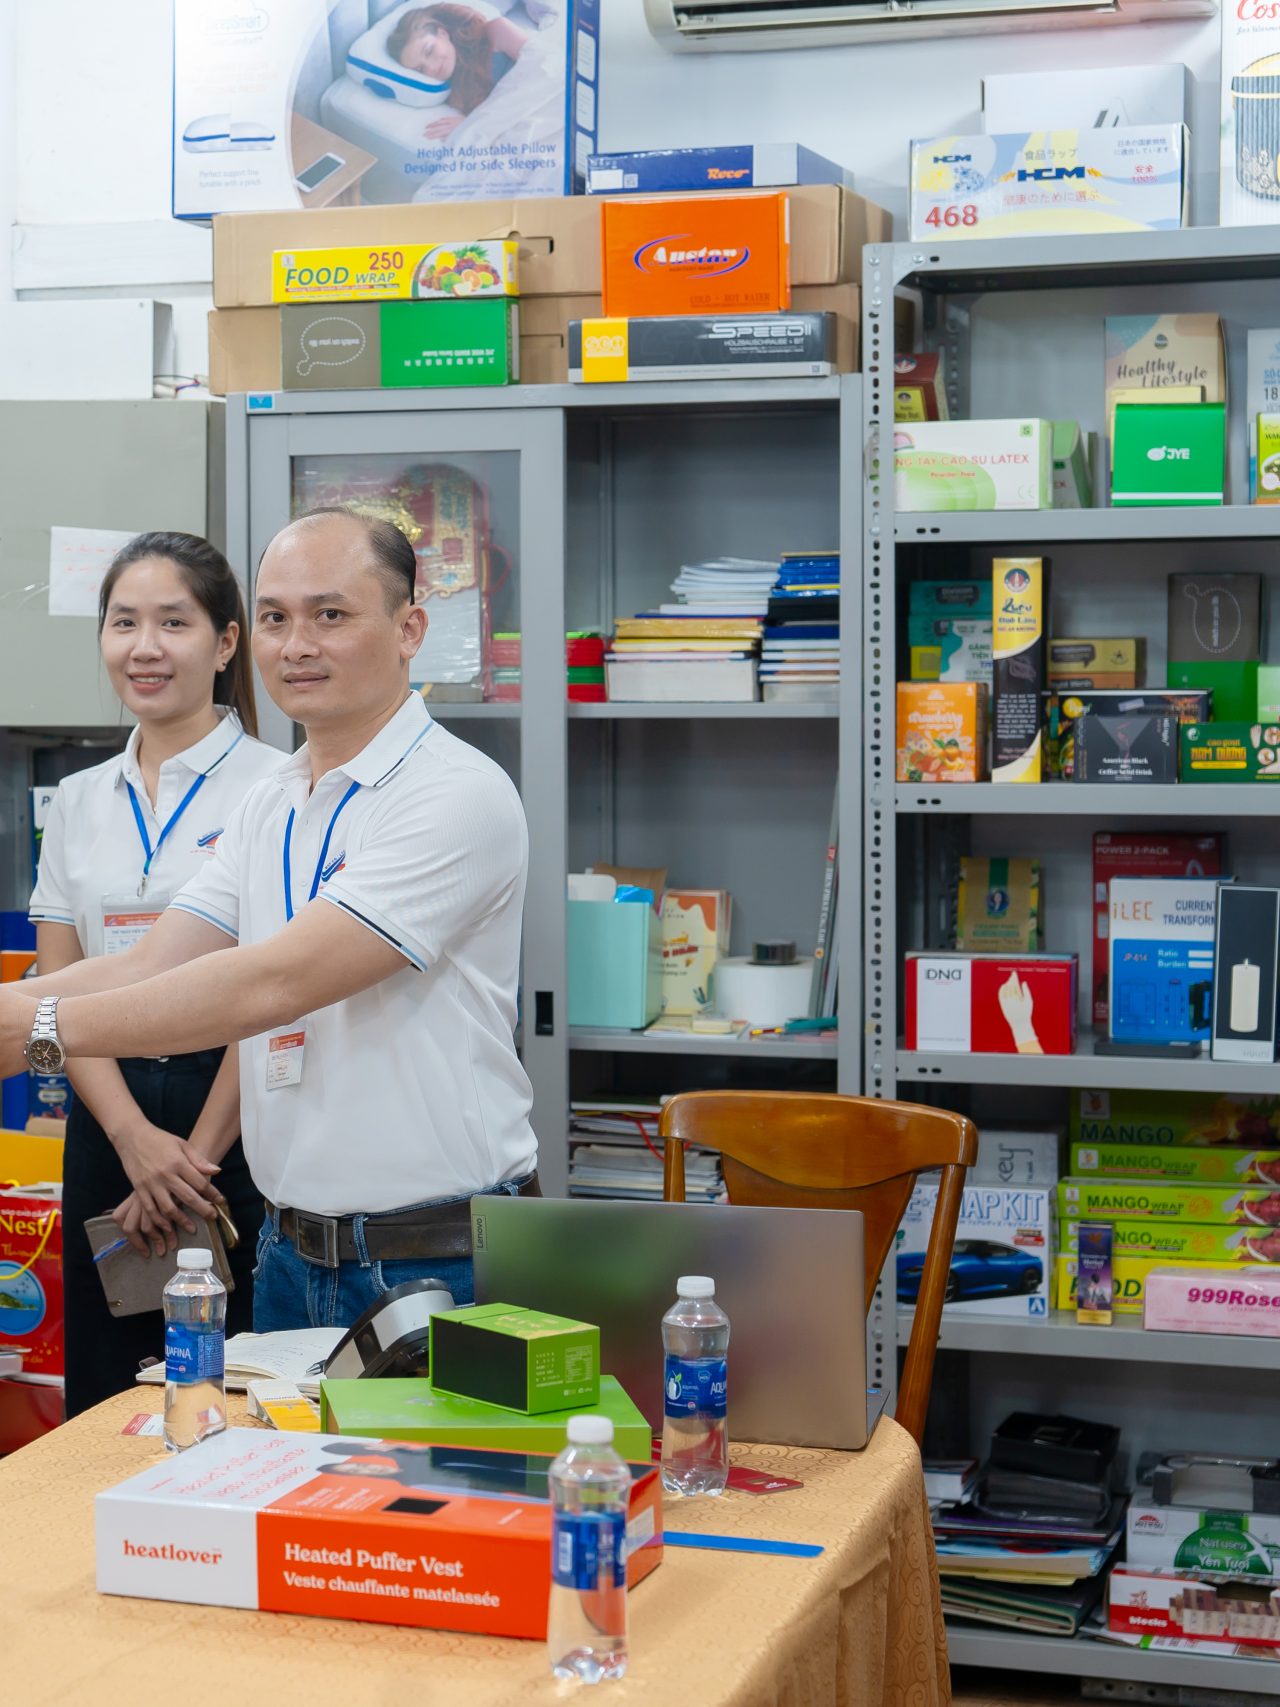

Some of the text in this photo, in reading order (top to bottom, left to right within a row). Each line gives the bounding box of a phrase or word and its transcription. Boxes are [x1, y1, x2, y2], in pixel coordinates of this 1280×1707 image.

[418, 141, 557, 160] Height Adjustable Pillow
[404, 163, 453, 177] Designed
[480, 159, 505, 171] Side
[925, 205, 978, 228] 468
[369, 251, 404, 271] 250
[285, 267, 396, 286] FOOD WRAP
[1117, 359, 1176, 381] Healthy
[991, 454, 1030, 465] LATEX
[1102, 757, 1149, 765] American Black
[1080, 1124, 1174, 1143] MANGO
[1101, 1154, 1163, 1168] MANGO
[1087, 1195, 1149, 1209] MANGO
[474, 1217, 485, 1249] Lenovo
[122, 1540, 222, 1565] heatlover
[284, 1543, 464, 1578] Heated Puffer Vest
[283, 1572, 501, 1608] Veste chauffante matelassée
